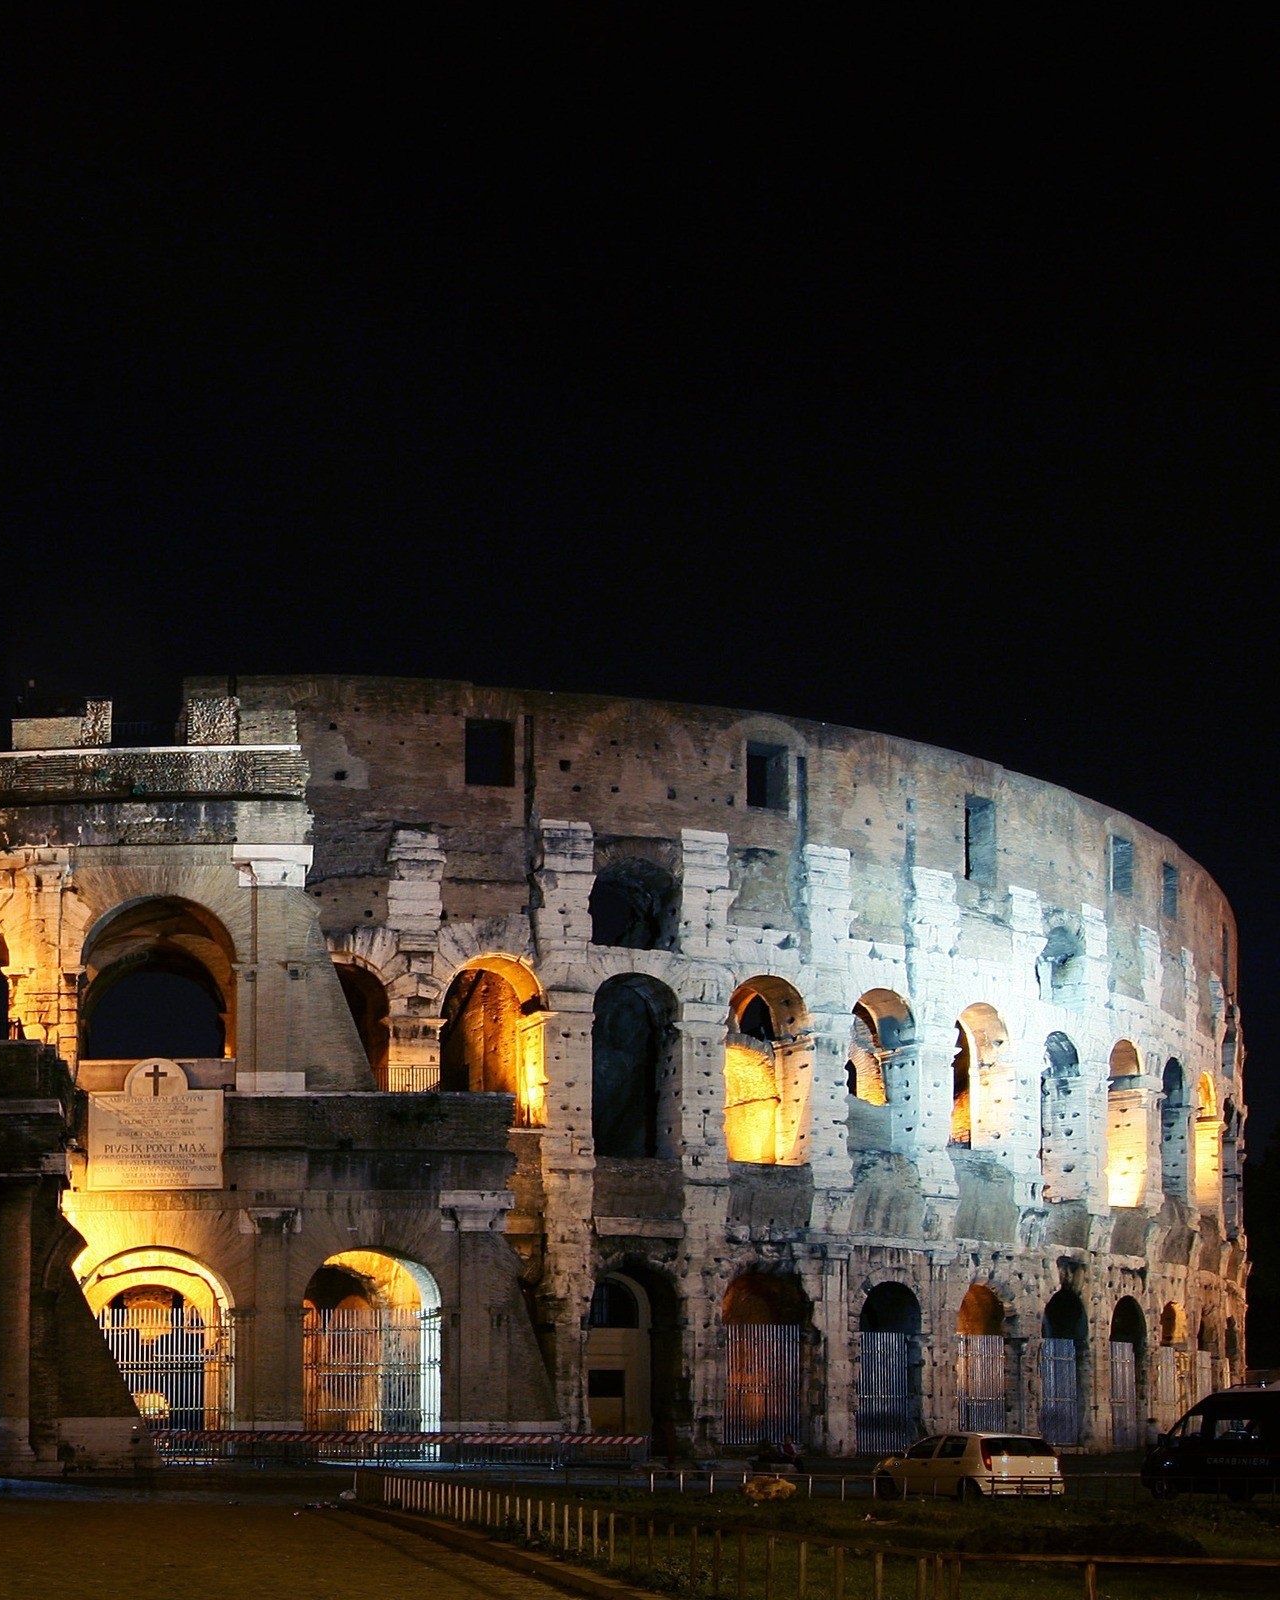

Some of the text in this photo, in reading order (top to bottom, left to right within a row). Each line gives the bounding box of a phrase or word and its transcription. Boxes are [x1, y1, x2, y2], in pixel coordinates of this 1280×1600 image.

[104, 1143, 206, 1153] PIVS IX PONT MAX
[1206, 1457, 1270, 1466] CARABINIERI
